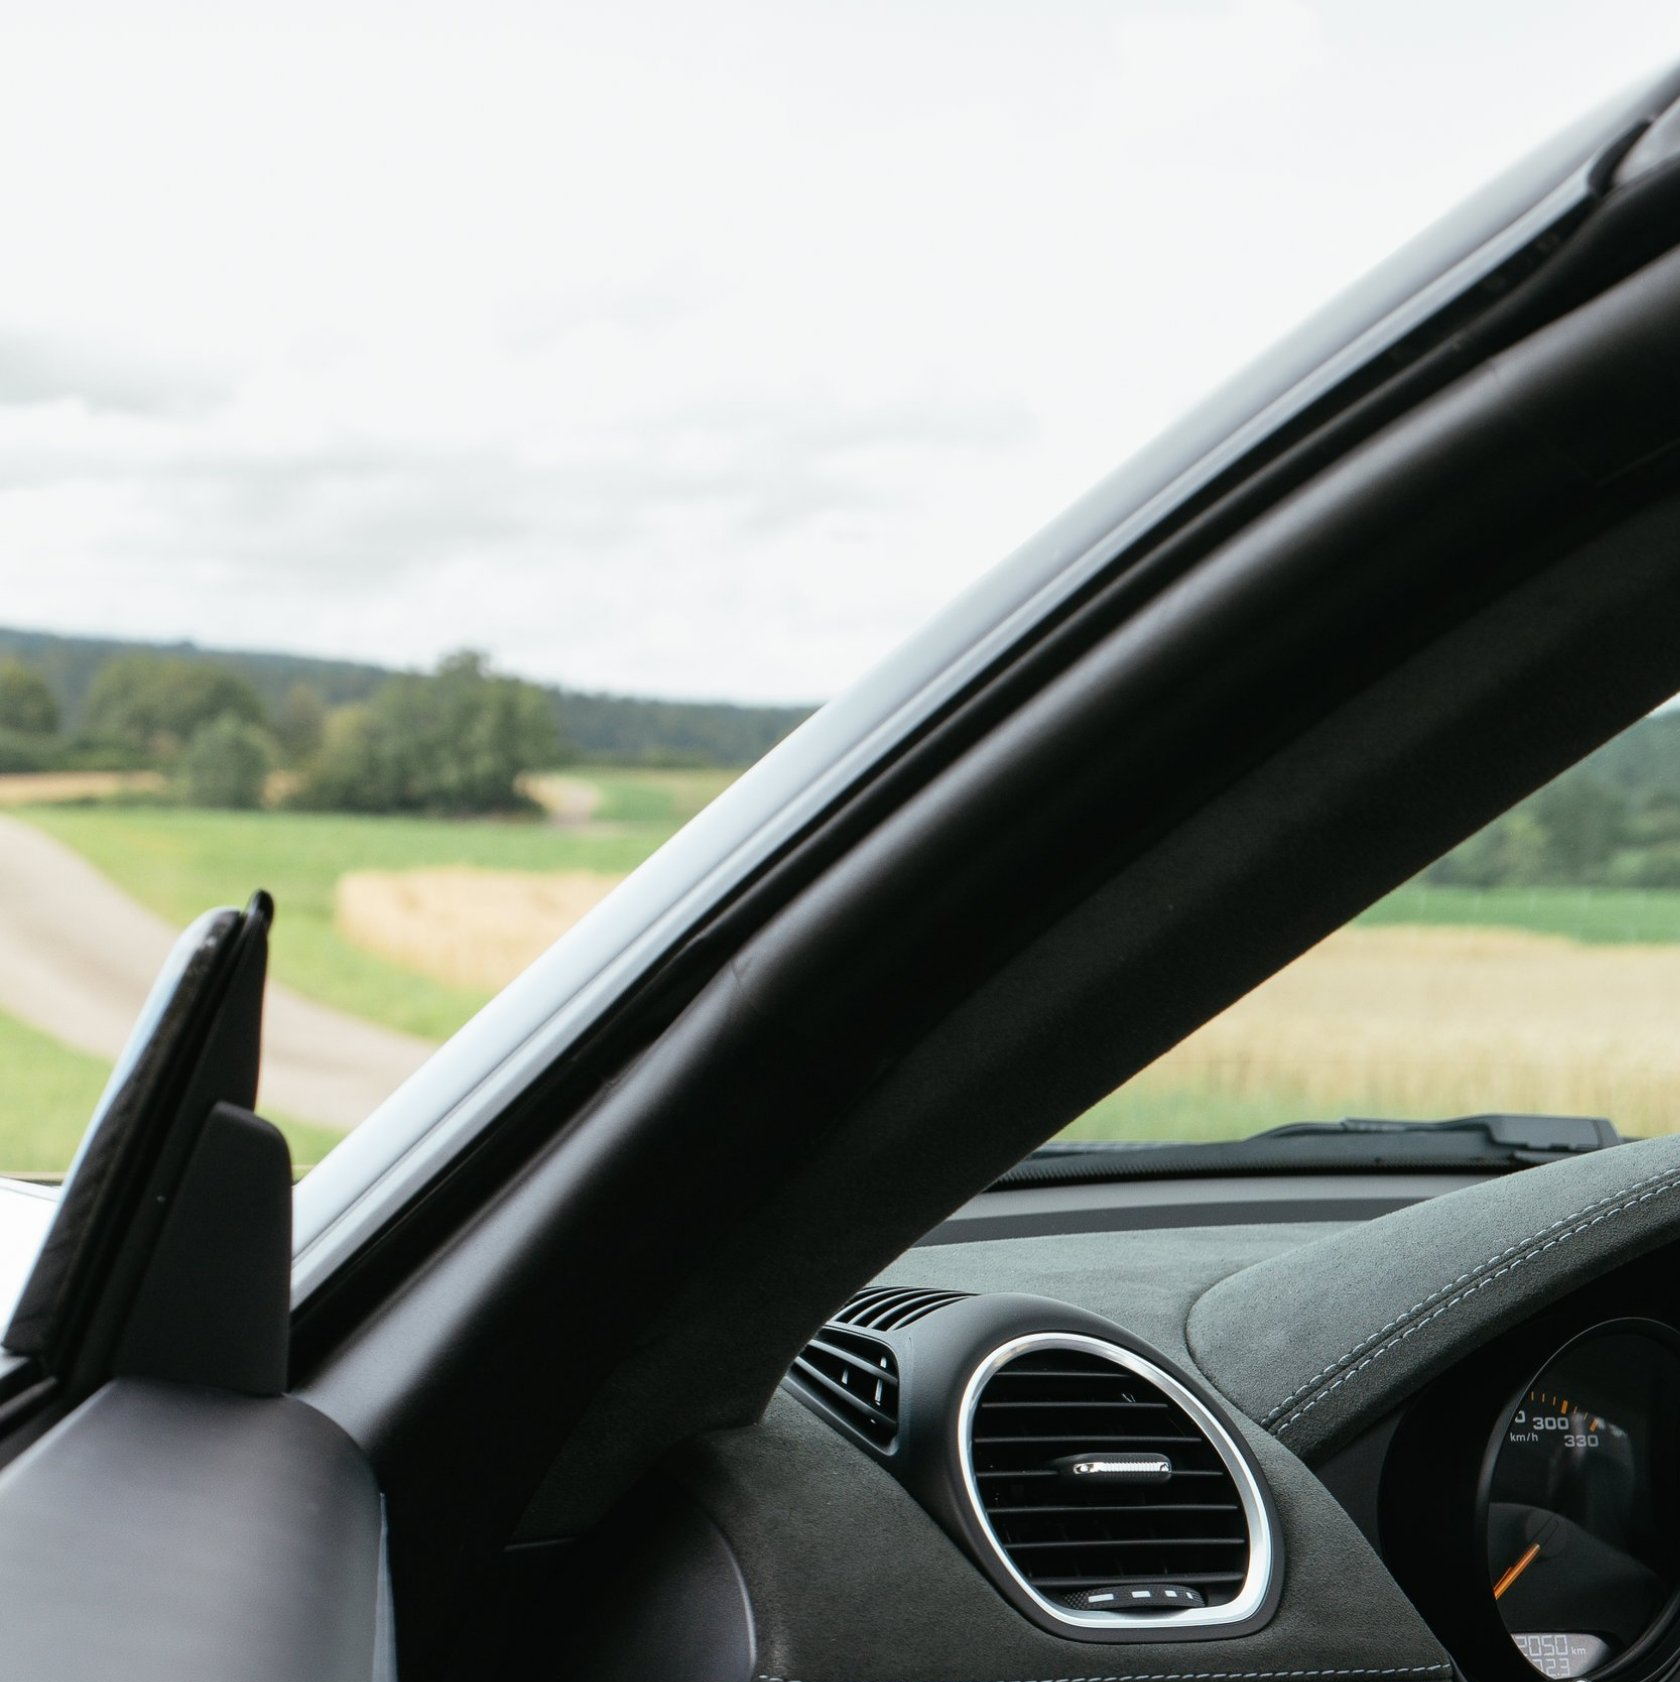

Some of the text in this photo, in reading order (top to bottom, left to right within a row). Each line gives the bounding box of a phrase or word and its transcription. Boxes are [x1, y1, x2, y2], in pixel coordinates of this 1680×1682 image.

[1532, 1417, 1570, 1430] 300
[1509, 1432, 1539, 1443] km/h
[1563, 1434, 1600, 1448] 330
[1570, 1646, 1587, 1656] km
